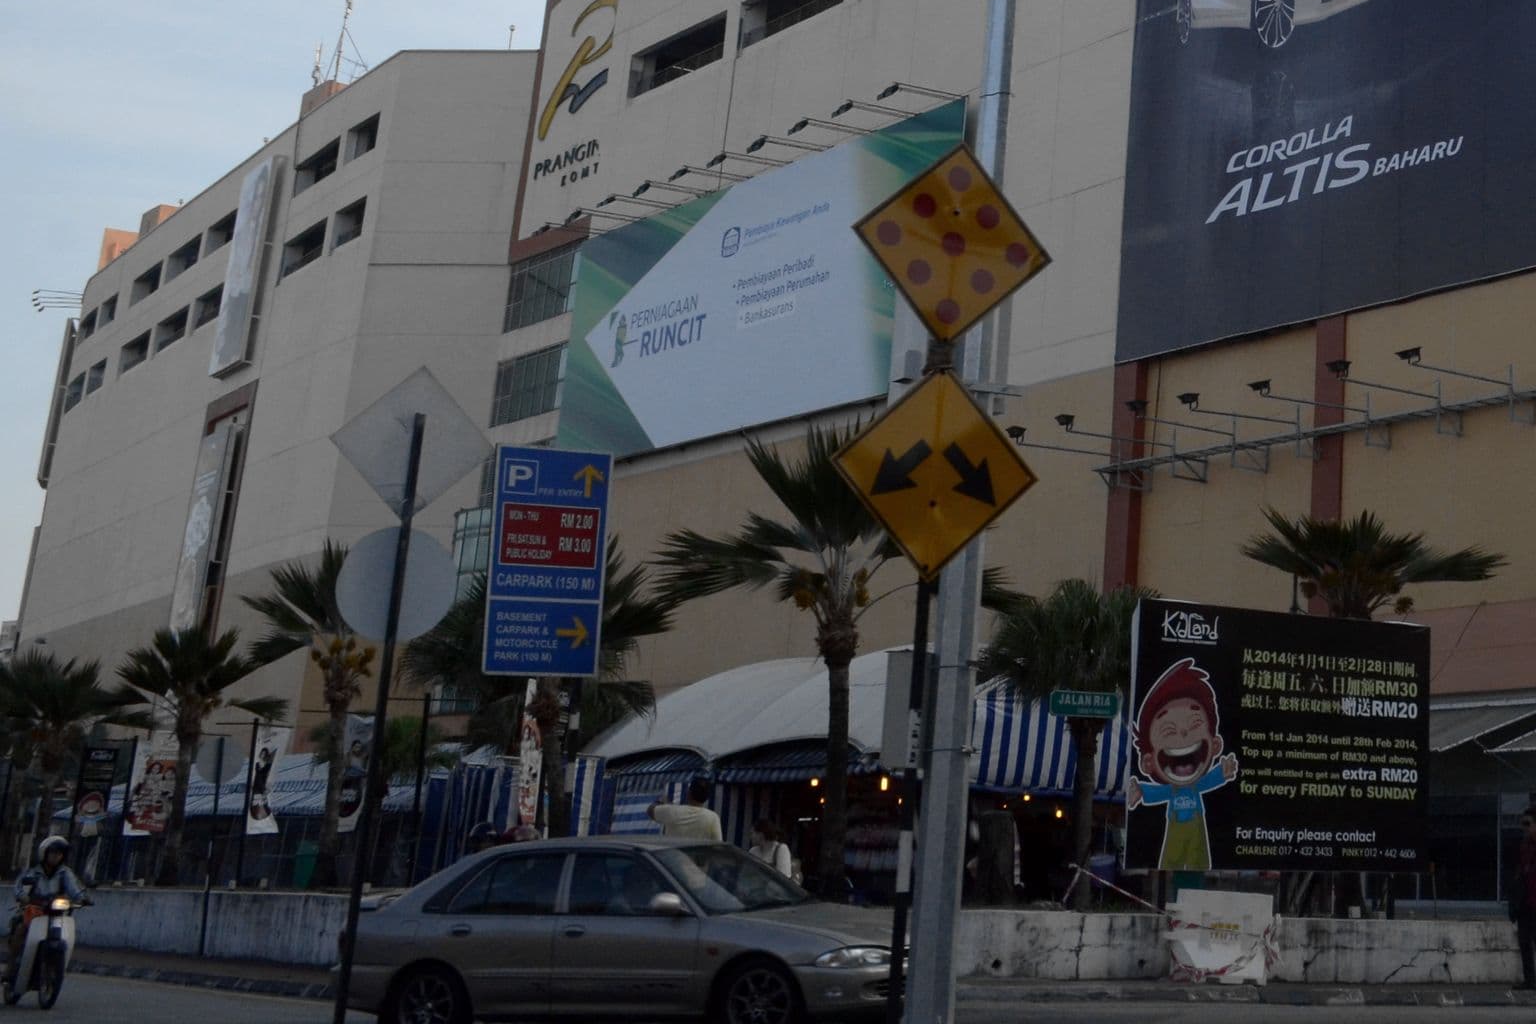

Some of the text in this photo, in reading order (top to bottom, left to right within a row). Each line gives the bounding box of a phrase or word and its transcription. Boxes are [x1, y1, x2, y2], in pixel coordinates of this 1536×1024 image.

[1226, 114, 1354, 174] COROLLA
[1204, 136, 1464, 225] ALTIS BAHARU
[631, 293, 699, 329] PERNIAGAAN
[640, 313, 707, 358] RUNCIT
[507, 465, 534, 488] P
[560, 513, 594, 529] RM 2.00
[559, 537, 592, 553] RM 3.00
[506, 547, 552, 560] PUBLIC HOLIDAY
[496, 573, 596, 591] CARPARK (150 M)
[496, 611, 546, 622] BASEMENT
[495, 625, 549, 636] CARPARK &
[495, 638, 559, 649] MOTORCYCLE
[494, 651, 519, 662] PARK
[541, 653, 552, 664] M)
[1059, 693, 1111, 706] JALAN RIA
[1241, 729, 1418, 750] From 1st Jan 2014 until 28th Feb 2014,
[1241, 746, 1258, 759] Top
[1262, 749, 1273, 759] up
[1285, 749, 1327, 761] minimum
[1330, 750, 1339, 760] of
[1342, 752, 1368, 763] RM30
[1370, 753, 1386, 764] and
[1388, 755, 1417, 766] above,
[1240, 767, 1418, 783] you will entitled to get an extra RM20
[1240, 781, 1417, 800] for every FRIDAY to SUNDAY
[1235, 827, 1376, 843] For Enquiry please contact
[1235, 845, 1277, 856] CHARLENE
[1278, 846, 1292, 856] 017
[1299, 846, 1313, 857] 432
[1342, 847, 1364, 857] PINKY
[1364, 848, 1377, 858] 012
